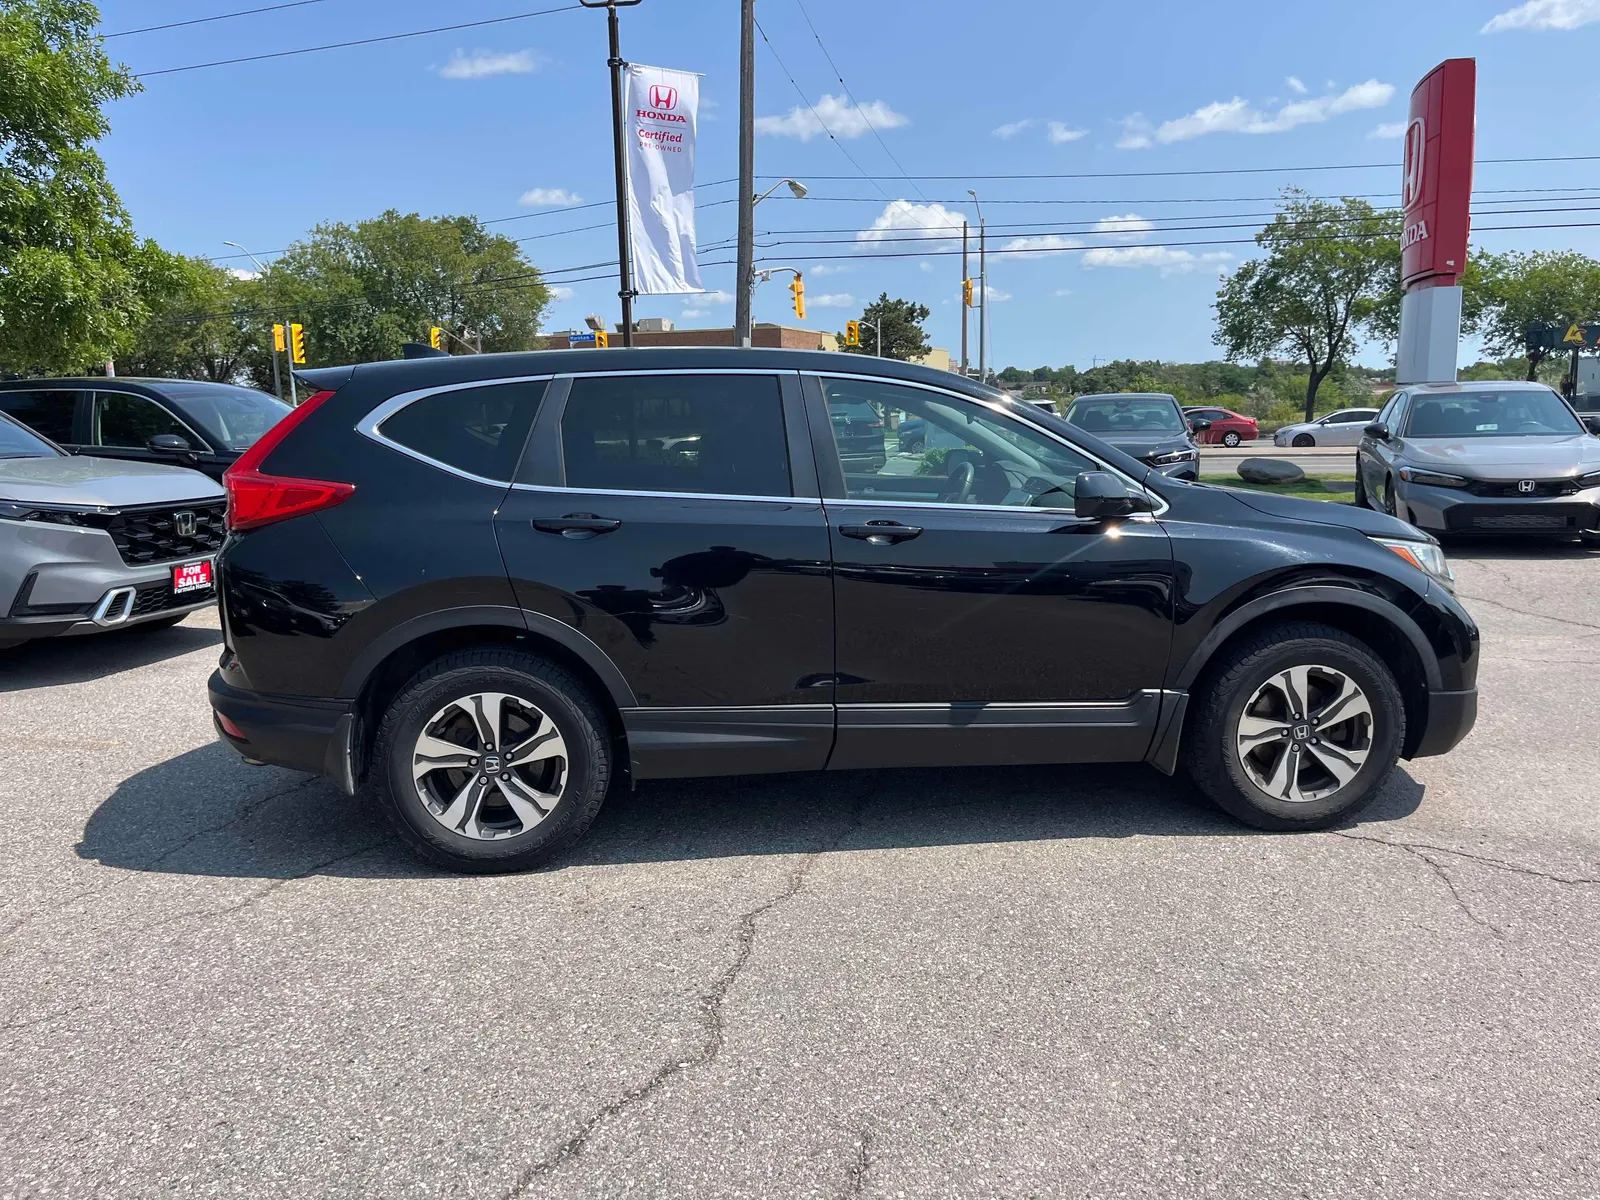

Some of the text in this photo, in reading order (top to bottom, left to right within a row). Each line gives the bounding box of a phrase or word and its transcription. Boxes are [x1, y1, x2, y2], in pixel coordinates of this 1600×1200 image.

[636, 110, 686, 122] HONDA
[638, 129, 682, 143] Certified
[639, 141, 682, 153] PRE-OWNED
[1400, 220, 1428, 252] NDA
[183, 565, 201, 577] FOR
[178, 574, 207, 588] SALE
[174, 585, 194, 594] Formula
